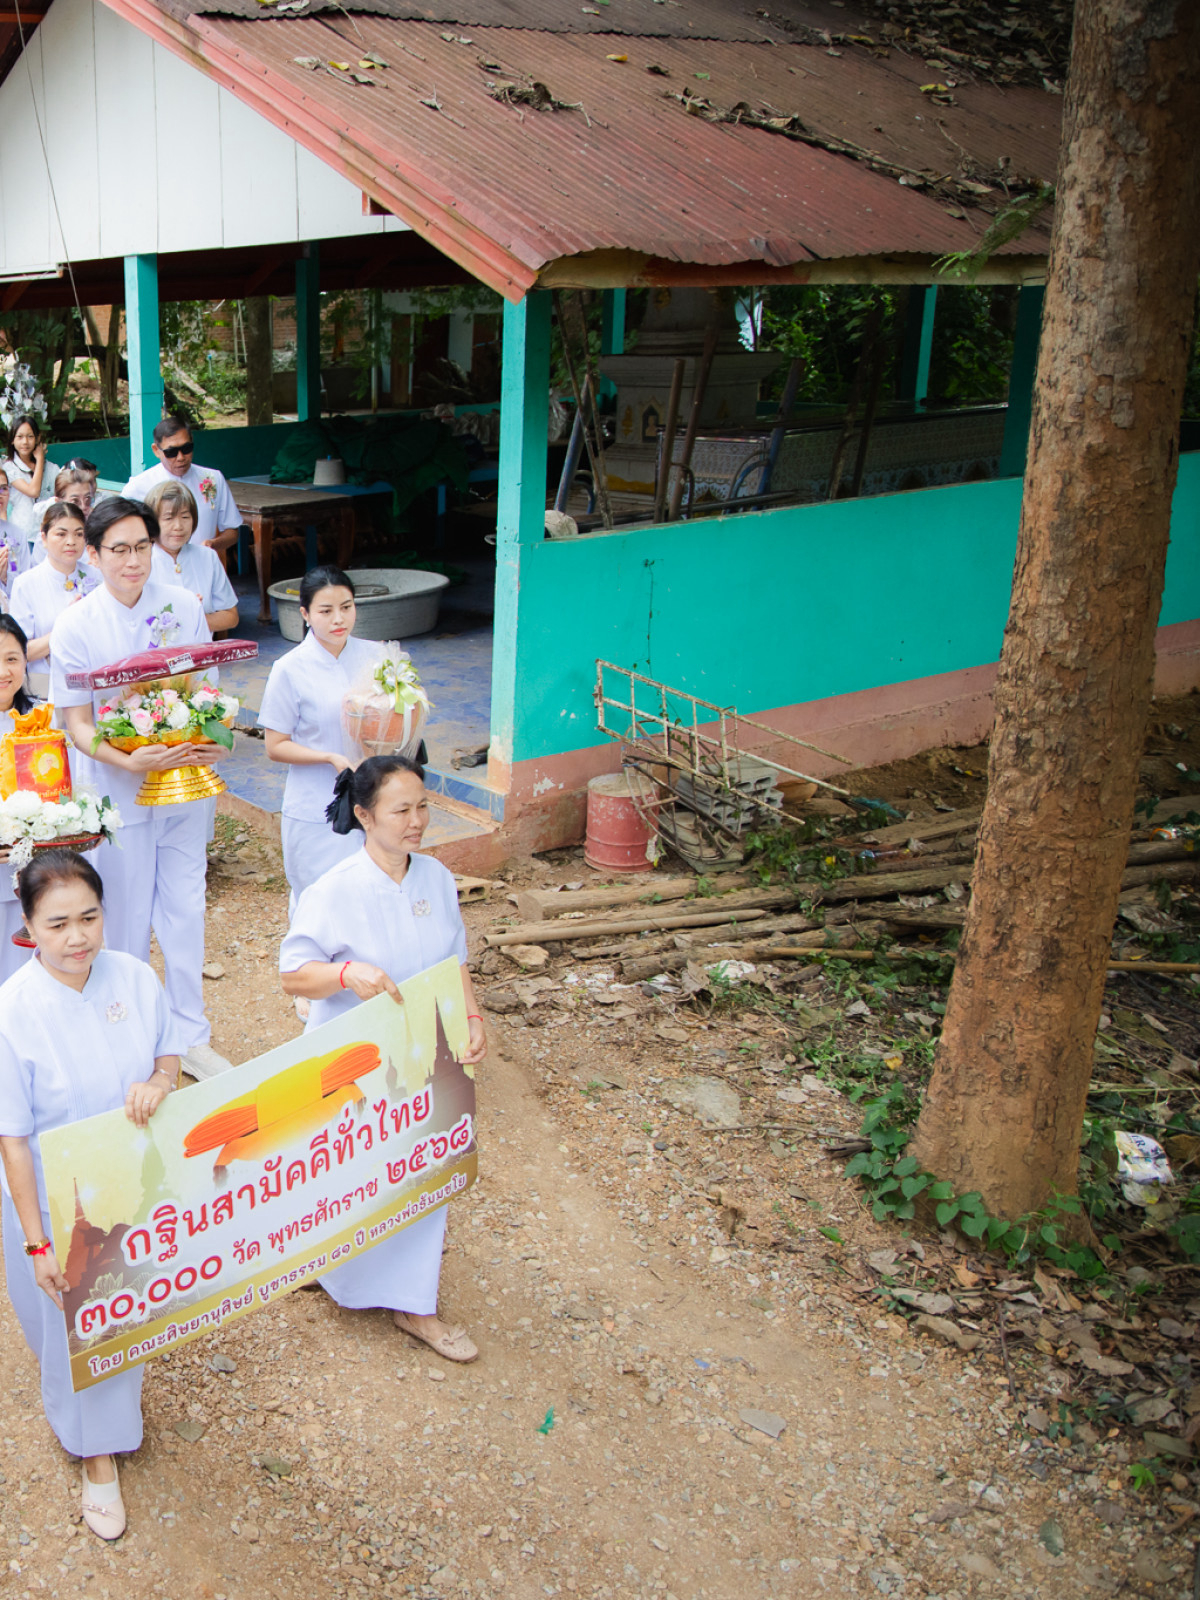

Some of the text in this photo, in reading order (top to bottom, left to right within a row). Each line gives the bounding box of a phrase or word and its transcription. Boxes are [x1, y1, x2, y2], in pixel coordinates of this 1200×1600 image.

[80, 1118, 470, 1334] ๓๐,๐๐๐ วัด พุทธศักราช ๒๕๖๘
[89, 1351, 122, 1375] โดย
[129, 1286, 253, 1359] คณะศิษยานุศิษย์
[258, 1254, 326, 1300] บูชาธรรม
[355, 1229, 365, 1246] ปี
[369, 1173, 466, 1239] หลวงพ่อธัมมชโย
[125, 1090, 430, 1262] กฐินสามัคคีทั่วไทย
